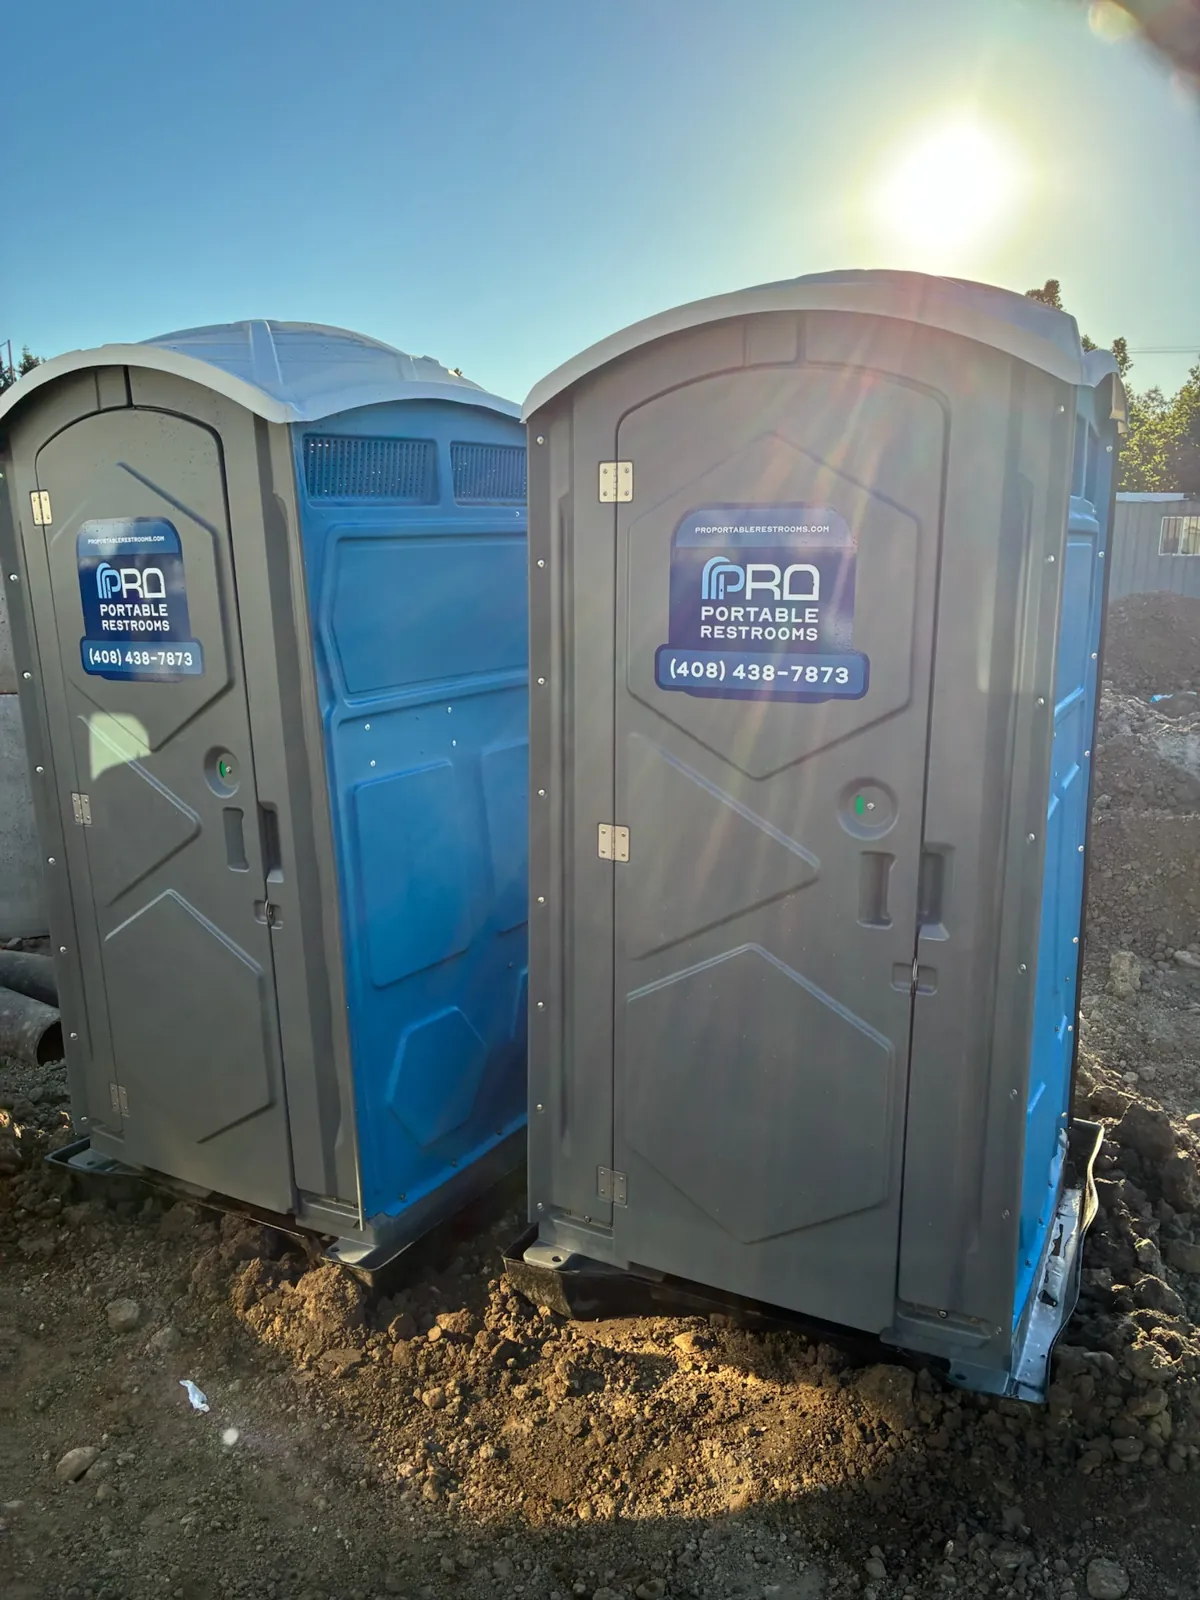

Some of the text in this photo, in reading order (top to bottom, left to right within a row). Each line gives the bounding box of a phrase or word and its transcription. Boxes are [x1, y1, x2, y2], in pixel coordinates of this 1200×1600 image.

[695, 526, 830, 534] PROPORTABLERESTROOMS.COM
[88, 536, 164, 545] PROPORTABLERESTROOMS.COM
[96, 563, 166, 599] PRO
[701, 556, 820, 601] PRO
[100, 604, 168, 616] PORTABLE
[701, 606, 820, 623] PORTABLE
[102, 620, 170, 631] RESTROOMS
[700, 626, 818, 641] RESTROOMS
[89, 648, 192, 666] (408) 438-7873
[670, 658, 849, 684] (408) 438-7873
